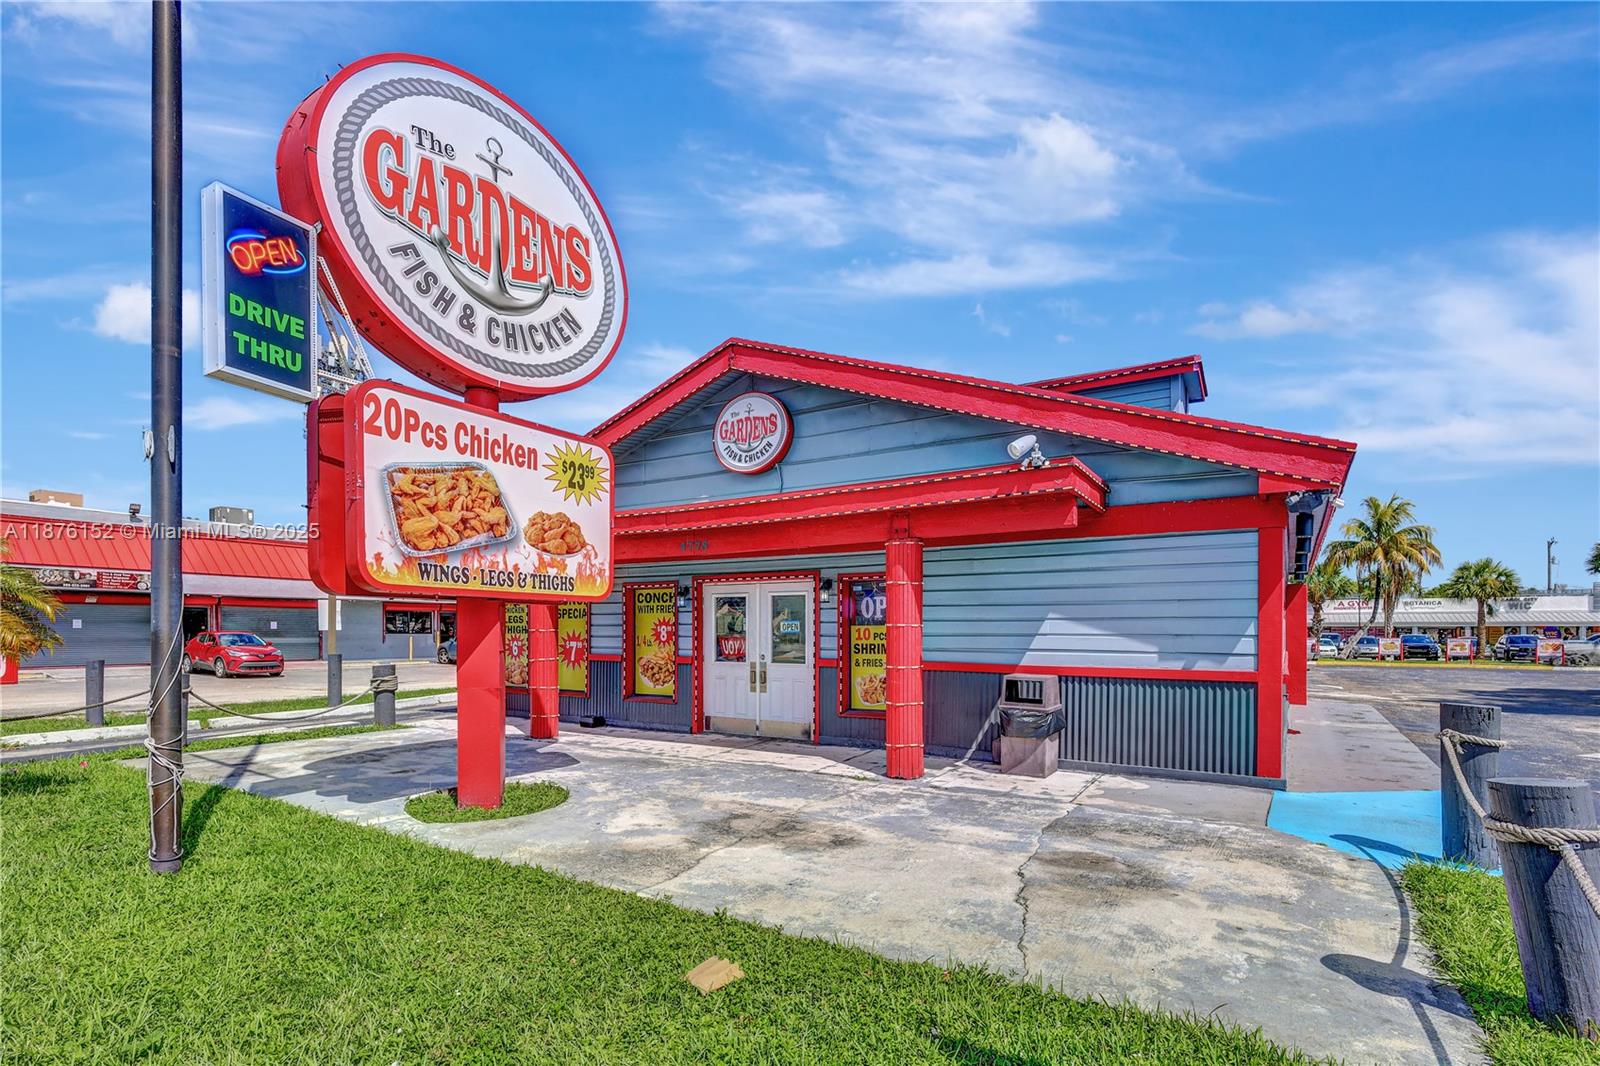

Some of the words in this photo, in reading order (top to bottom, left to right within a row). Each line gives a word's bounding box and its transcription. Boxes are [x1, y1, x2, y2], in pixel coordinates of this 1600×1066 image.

[411, 124, 456, 158] The
[362, 129, 592, 294] GARDENS
[231, 238, 298, 270] OPEN
[389, 242, 457, 315] FISH
[459, 303, 477, 334] &
[486, 306, 584, 353] CHICKEN
[229, 292, 305, 339] DRIVE
[233, 331, 303, 372] THRU
[363, 392, 448, 451] 20Pcs
[454, 421, 538, 471] Chicken
[719, 413, 777, 442] GARDENS
[723, 445, 737, 461] FISH
[744, 440, 773, 464] CHICKEN
[417, 562, 469, 585] WINGS
[480, 568, 514, 588] LEGS
[516, 570, 528, 589] &
[529, 573, 575, 592] THIGHS
[507, 615, 524, 624] EGS
[638, 605, 655, 614] WITH
[1507, 602, 1532, 610] WIC
[782, 623, 799, 631] OPEN
[856, 627, 871, 641] 10
[854, 658, 861, 667] &
[862, 658, 884, 668] FRIES
